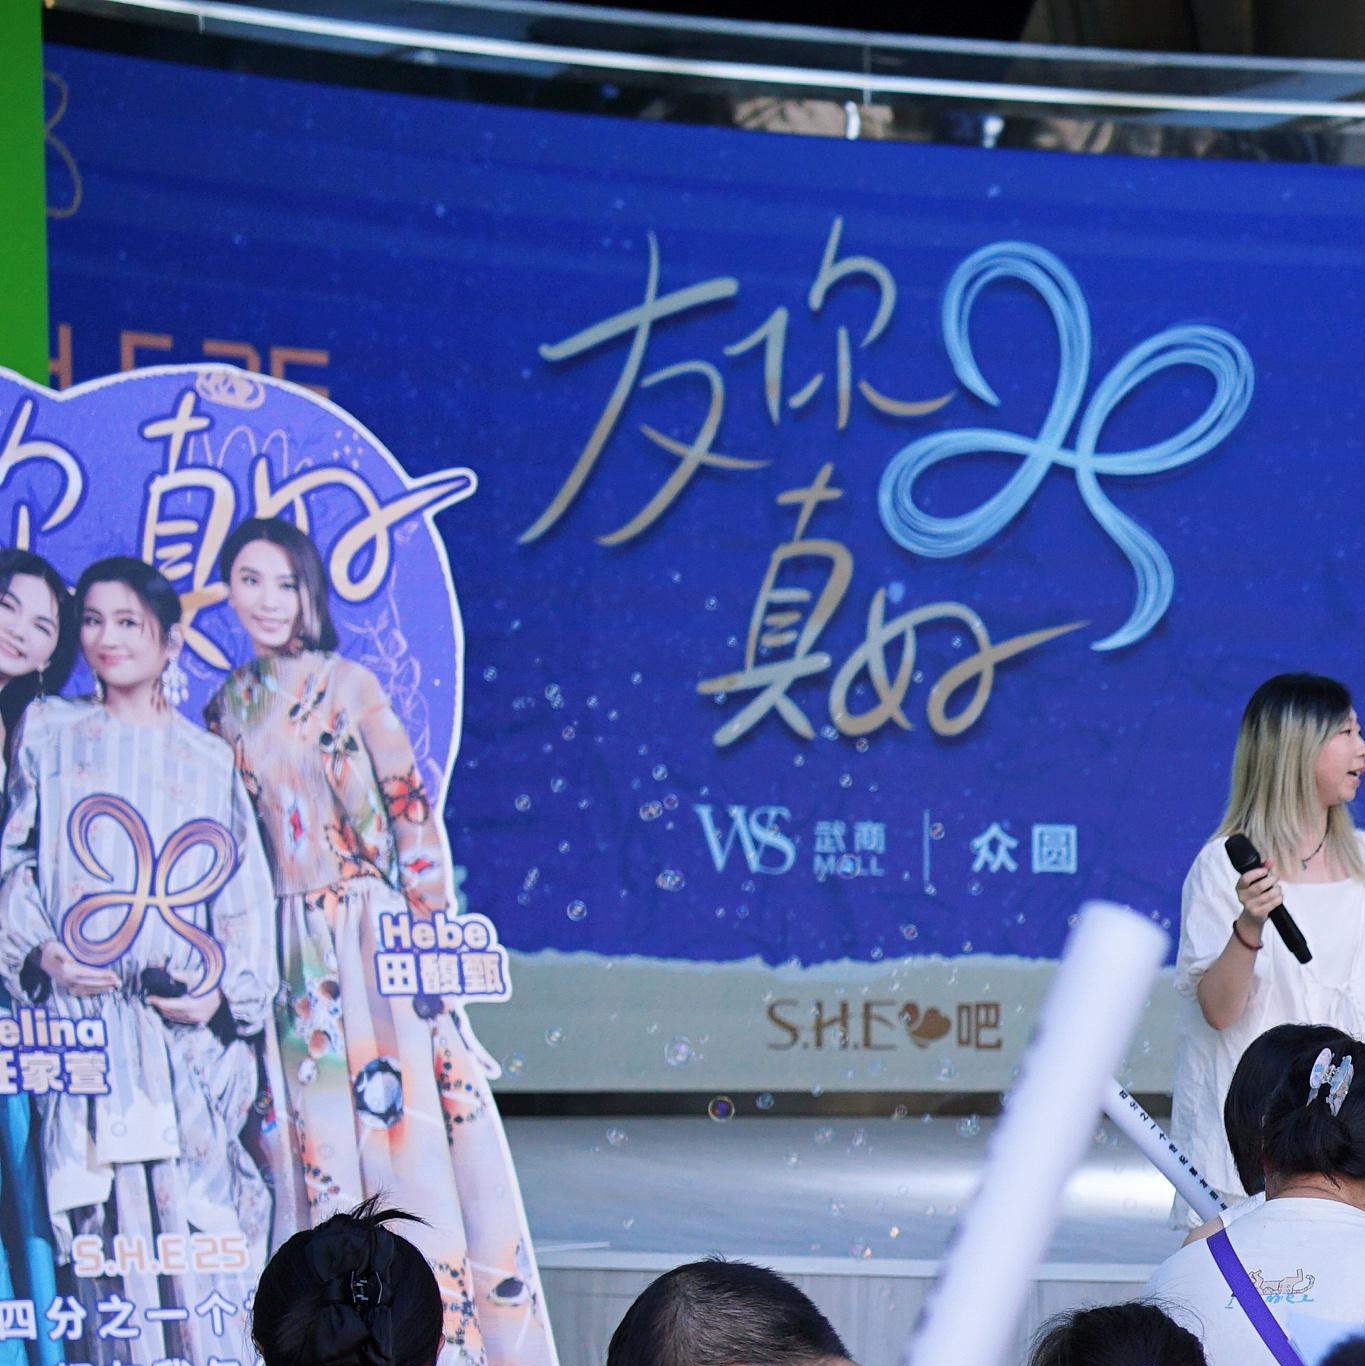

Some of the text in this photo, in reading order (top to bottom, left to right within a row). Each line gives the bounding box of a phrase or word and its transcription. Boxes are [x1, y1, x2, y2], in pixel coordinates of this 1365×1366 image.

[694, 803, 797, 876] WS
[814, 820, 886, 853] 武商
[381, 912, 489, 950] Hebe
[0, 1007, 106, 1048] elina
[0, 1290, 255, 1342] 四分之一个
